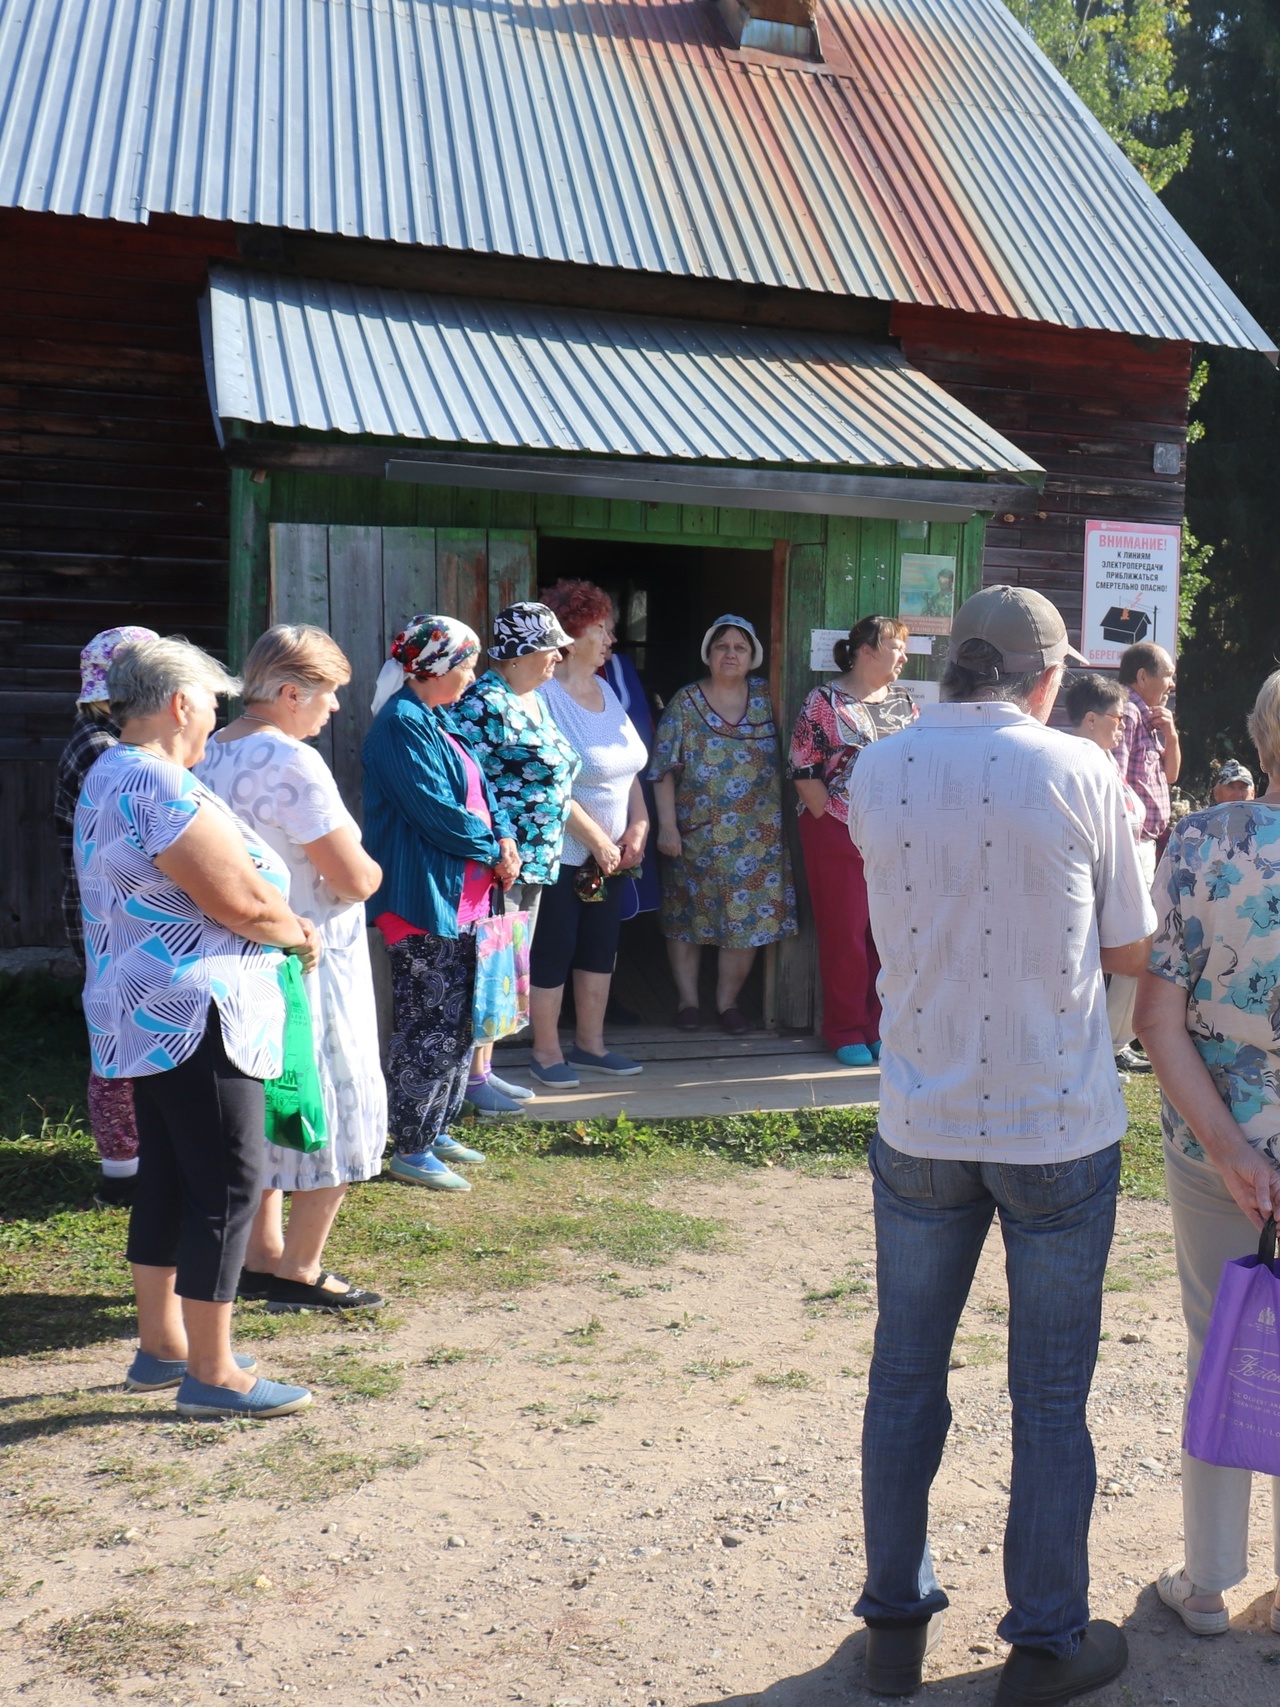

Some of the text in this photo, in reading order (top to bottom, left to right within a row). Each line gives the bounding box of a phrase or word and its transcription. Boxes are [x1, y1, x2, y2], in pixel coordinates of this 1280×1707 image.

[1099, 534, 1167, 551] ВНИМАНИЕ!
[1123, 552, 1151, 560] ЛИНИЯМ
[1101, 561, 1163, 572] ЭЛЕКТРОПЕРЕДАЧИ
[1106, 571, 1159, 581] ПРИБЛИЖАТЬСЯ
[1095, 581, 1168, 592] СМЕРТЕЛЬНО ОПАСНО!
